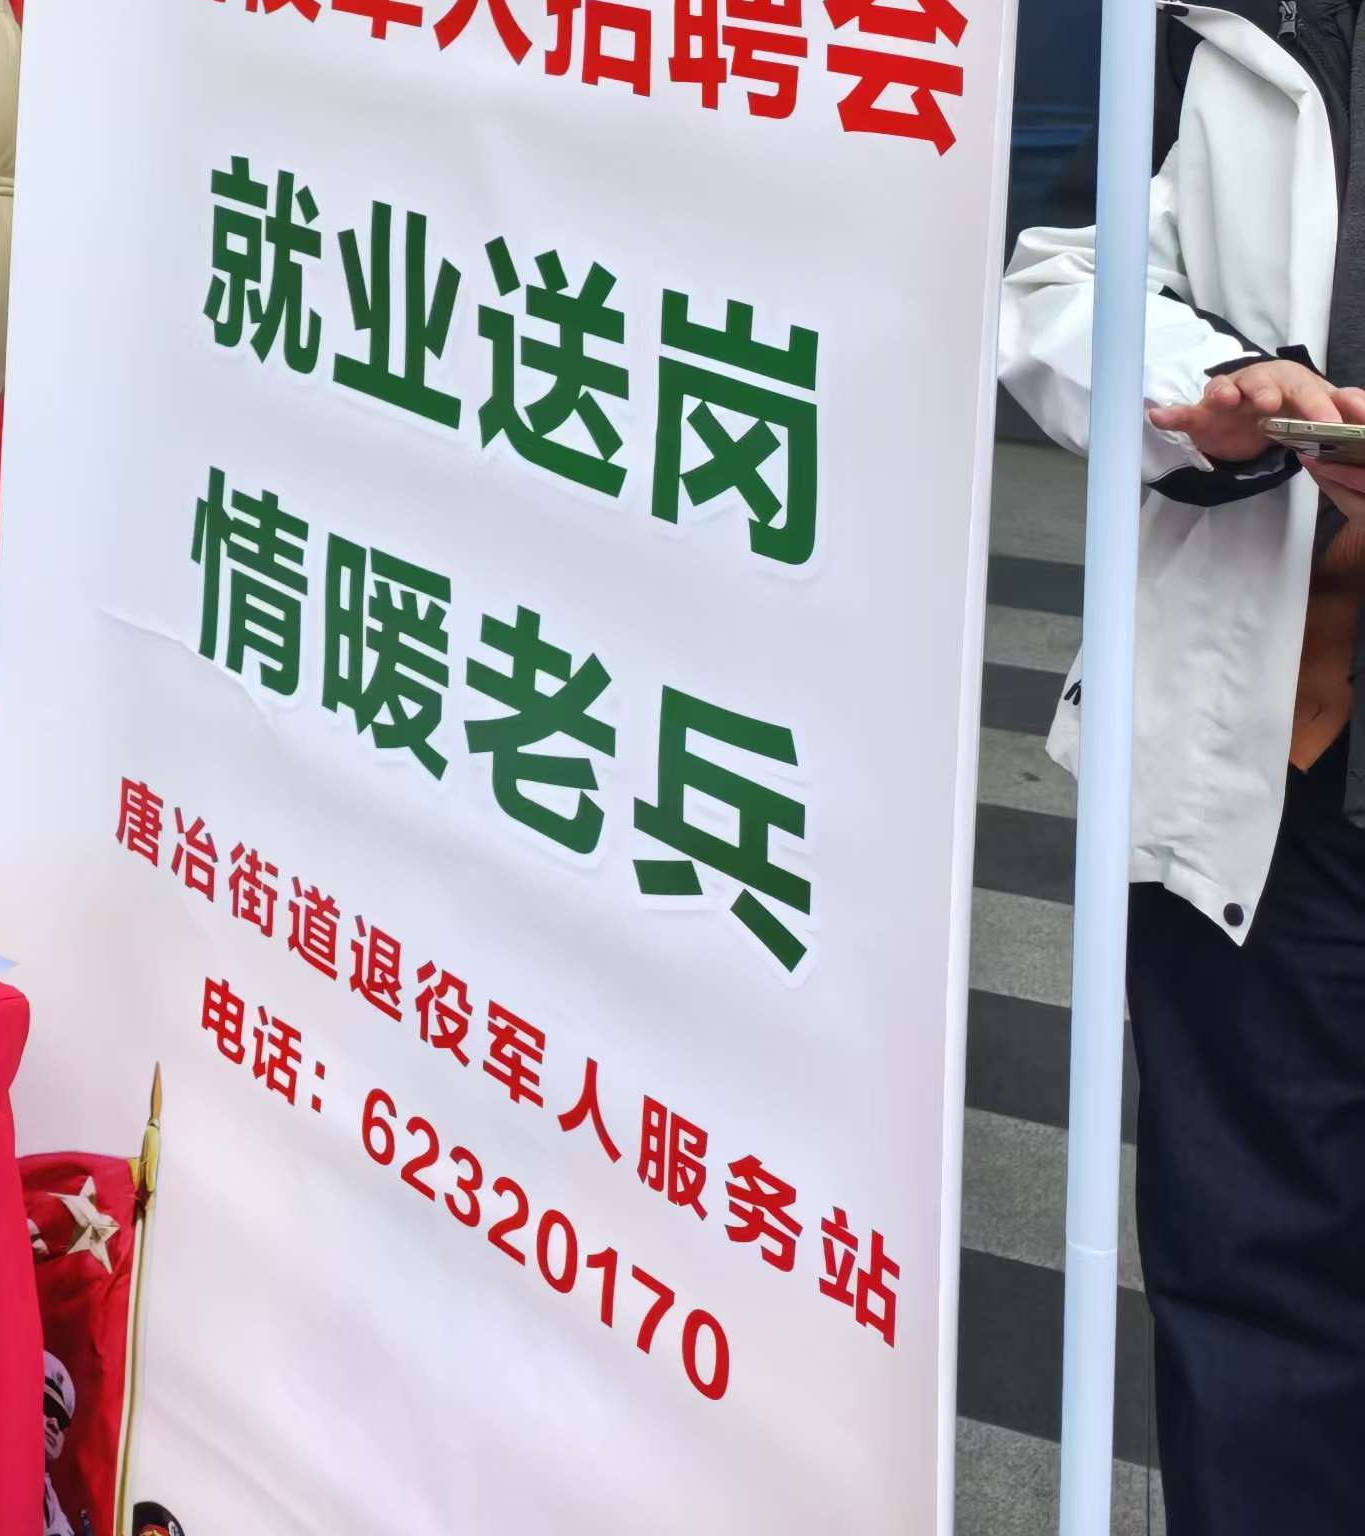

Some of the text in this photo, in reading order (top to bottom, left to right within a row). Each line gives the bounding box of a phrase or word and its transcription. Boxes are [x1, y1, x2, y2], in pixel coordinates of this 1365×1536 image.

[202, 155, 820, 566] 就业送岗
[190, 465, 812, 973] 情暖老兵
[114, 776, 901, 1349] 唐冶街道退役军人服务站
